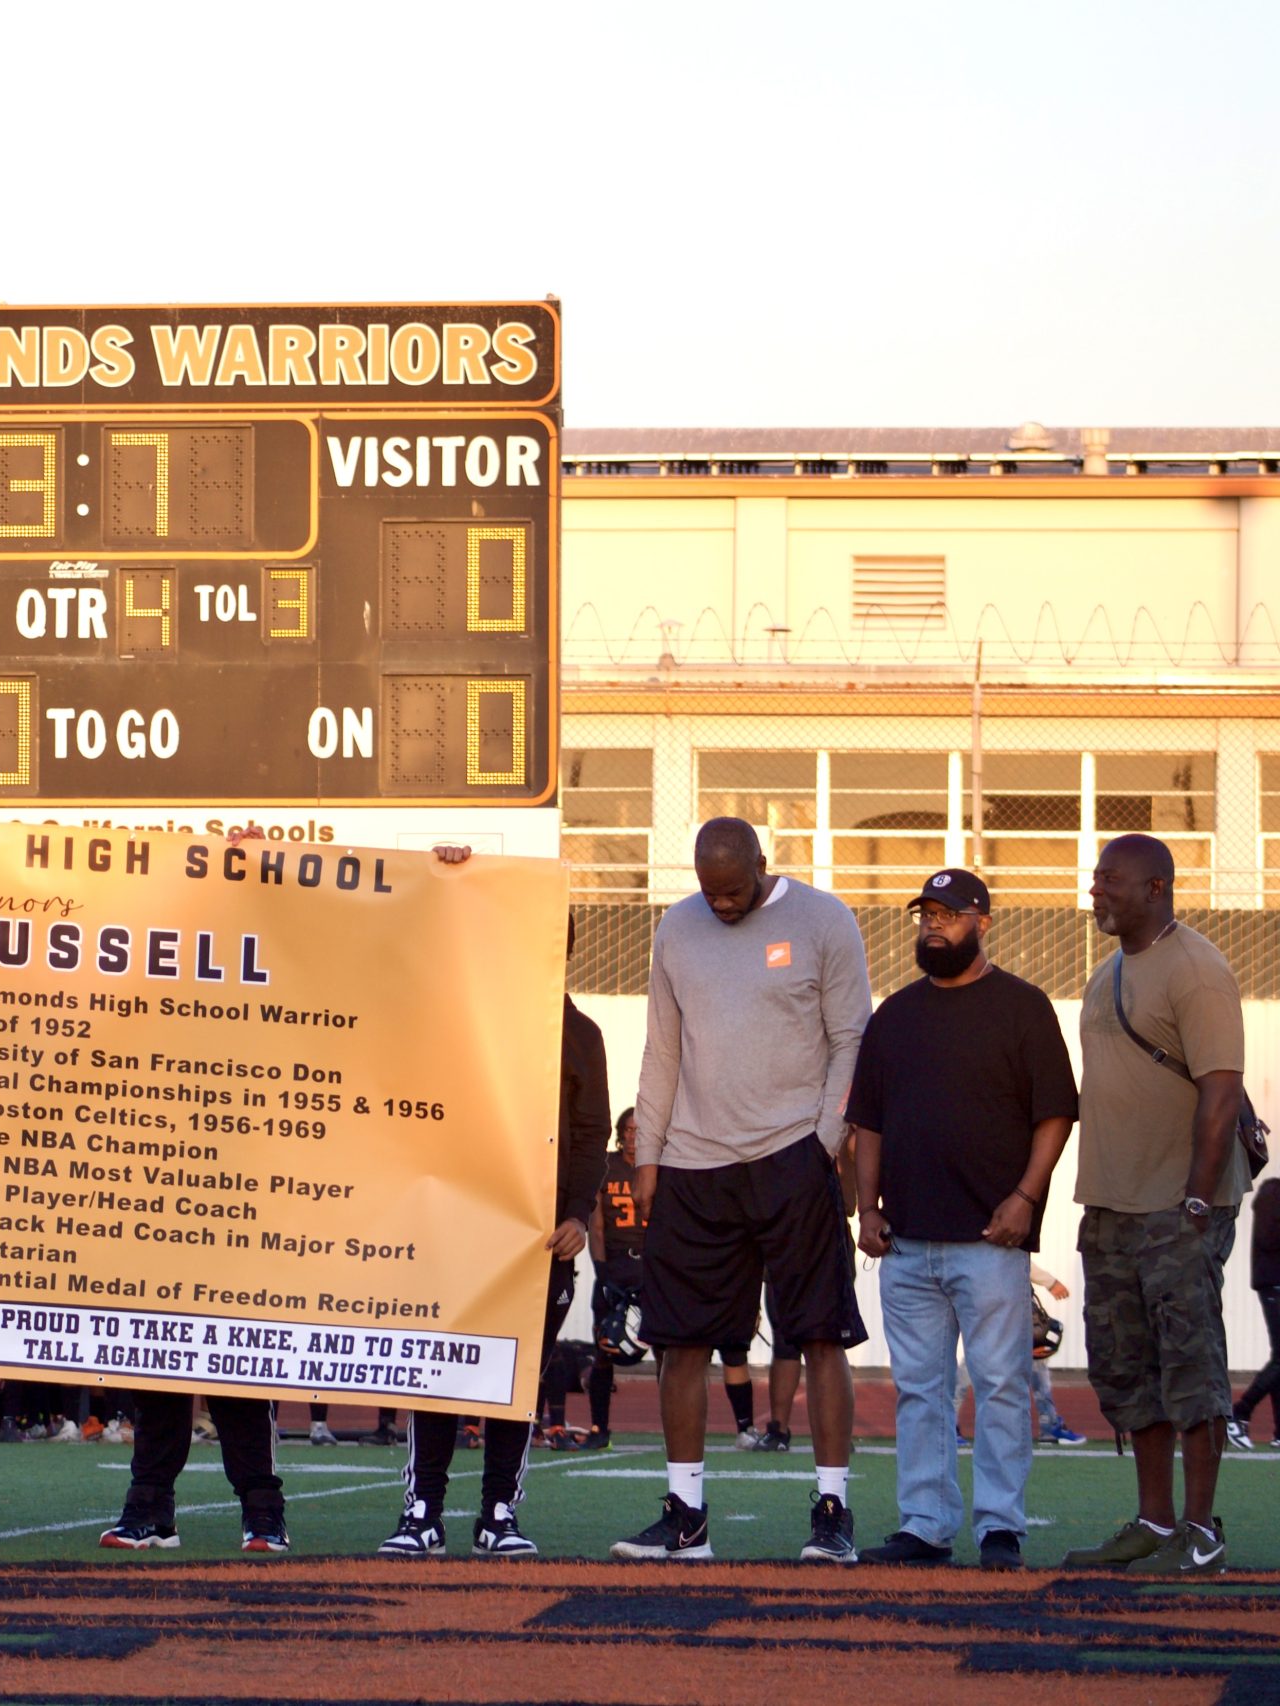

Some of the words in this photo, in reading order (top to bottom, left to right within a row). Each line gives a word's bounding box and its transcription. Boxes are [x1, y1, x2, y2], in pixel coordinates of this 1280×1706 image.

[150, 322, 539, 387] WARRIORS
[326, 435, 541, 488] VISITOR
[194, 584, 257, 622] TOL
[270, 570, 308, 638] 3
[466, 527, 526, 632] 0
[16, 587, 108, 639] QTR
[125, 579, 170, 646] 4
[307, 707, 373, 759] ON
[466, 680, 526, 785] 0
[25, 833, 150, 876] HIGH
[185, 844, 393, 894] SCHOOL
[30, 1016, 92, 1039] 1952
[89, 992, 149, 1018] High
[159, 997, 249, 1022] School
[259, 1003, 359, 1029] Warrior
[54, 1047, 81, 1067] of
[90, 1049, 139, 1071] San
[150, 1053, 282, 1080] Francisco
[292, 1062, 342, 1085] Don
[29, 1073, 233, 1108] Championships
[243, 1087, 266, 1108] in
[278, 1090, 342, 1113] 1955
[352, 1095, 371, 1115] &
[383, 1098, 445, 1121] 1956
[21, 1128, 77, 1151] NBA
[86, 1133, 218, 1162] Champion
[74, 1104, 176, 1134] Celtics,
[188, 1112, 327, 1140] 1956-1969
[3, 1155, 59, 1178] NBA
[69, 1160, 133, 1184] Most
[142, 1165, 259, 1192] Valuable
[269, 1175, 355, 1202] Player
[5, 1184, 165, 1214] Player/Head
[175, 1196, 257, 1221] Coach
[56, 1216, 124, 1239] Head
[133, 1222, 216, 1246] Coach
[226, 1228, 250, 1249] in
[260, 1231, 336, 1258] Major
[344, 1237, 416, 1262] Sport
[67, 1273, 146, 1298] Medal
[156, 1281, 183, 1300] of
[193, 1283, 307, 1310] Freedom
[317, 1292, 441, 1320] Recipient
[23, 1338, 84, 1363] TALL
[93, 1343, 199, 1372] AGAINST
[207, 1352, 289, 1379] SOCIAL
[298, 1359, 442, 1389] INJUSTICE."
[89, 1315, 120, 1338] TO
[129, 1318, 194, 1344] TAKE
[202, 1324, 218, 1346] A
[227, 1326, 298, 1355] KNEE,
[306, 1332, 355, 1356] AND
[364, 1335, 393, 1358] TO
[400, 1338, 481, 1366] STAND
